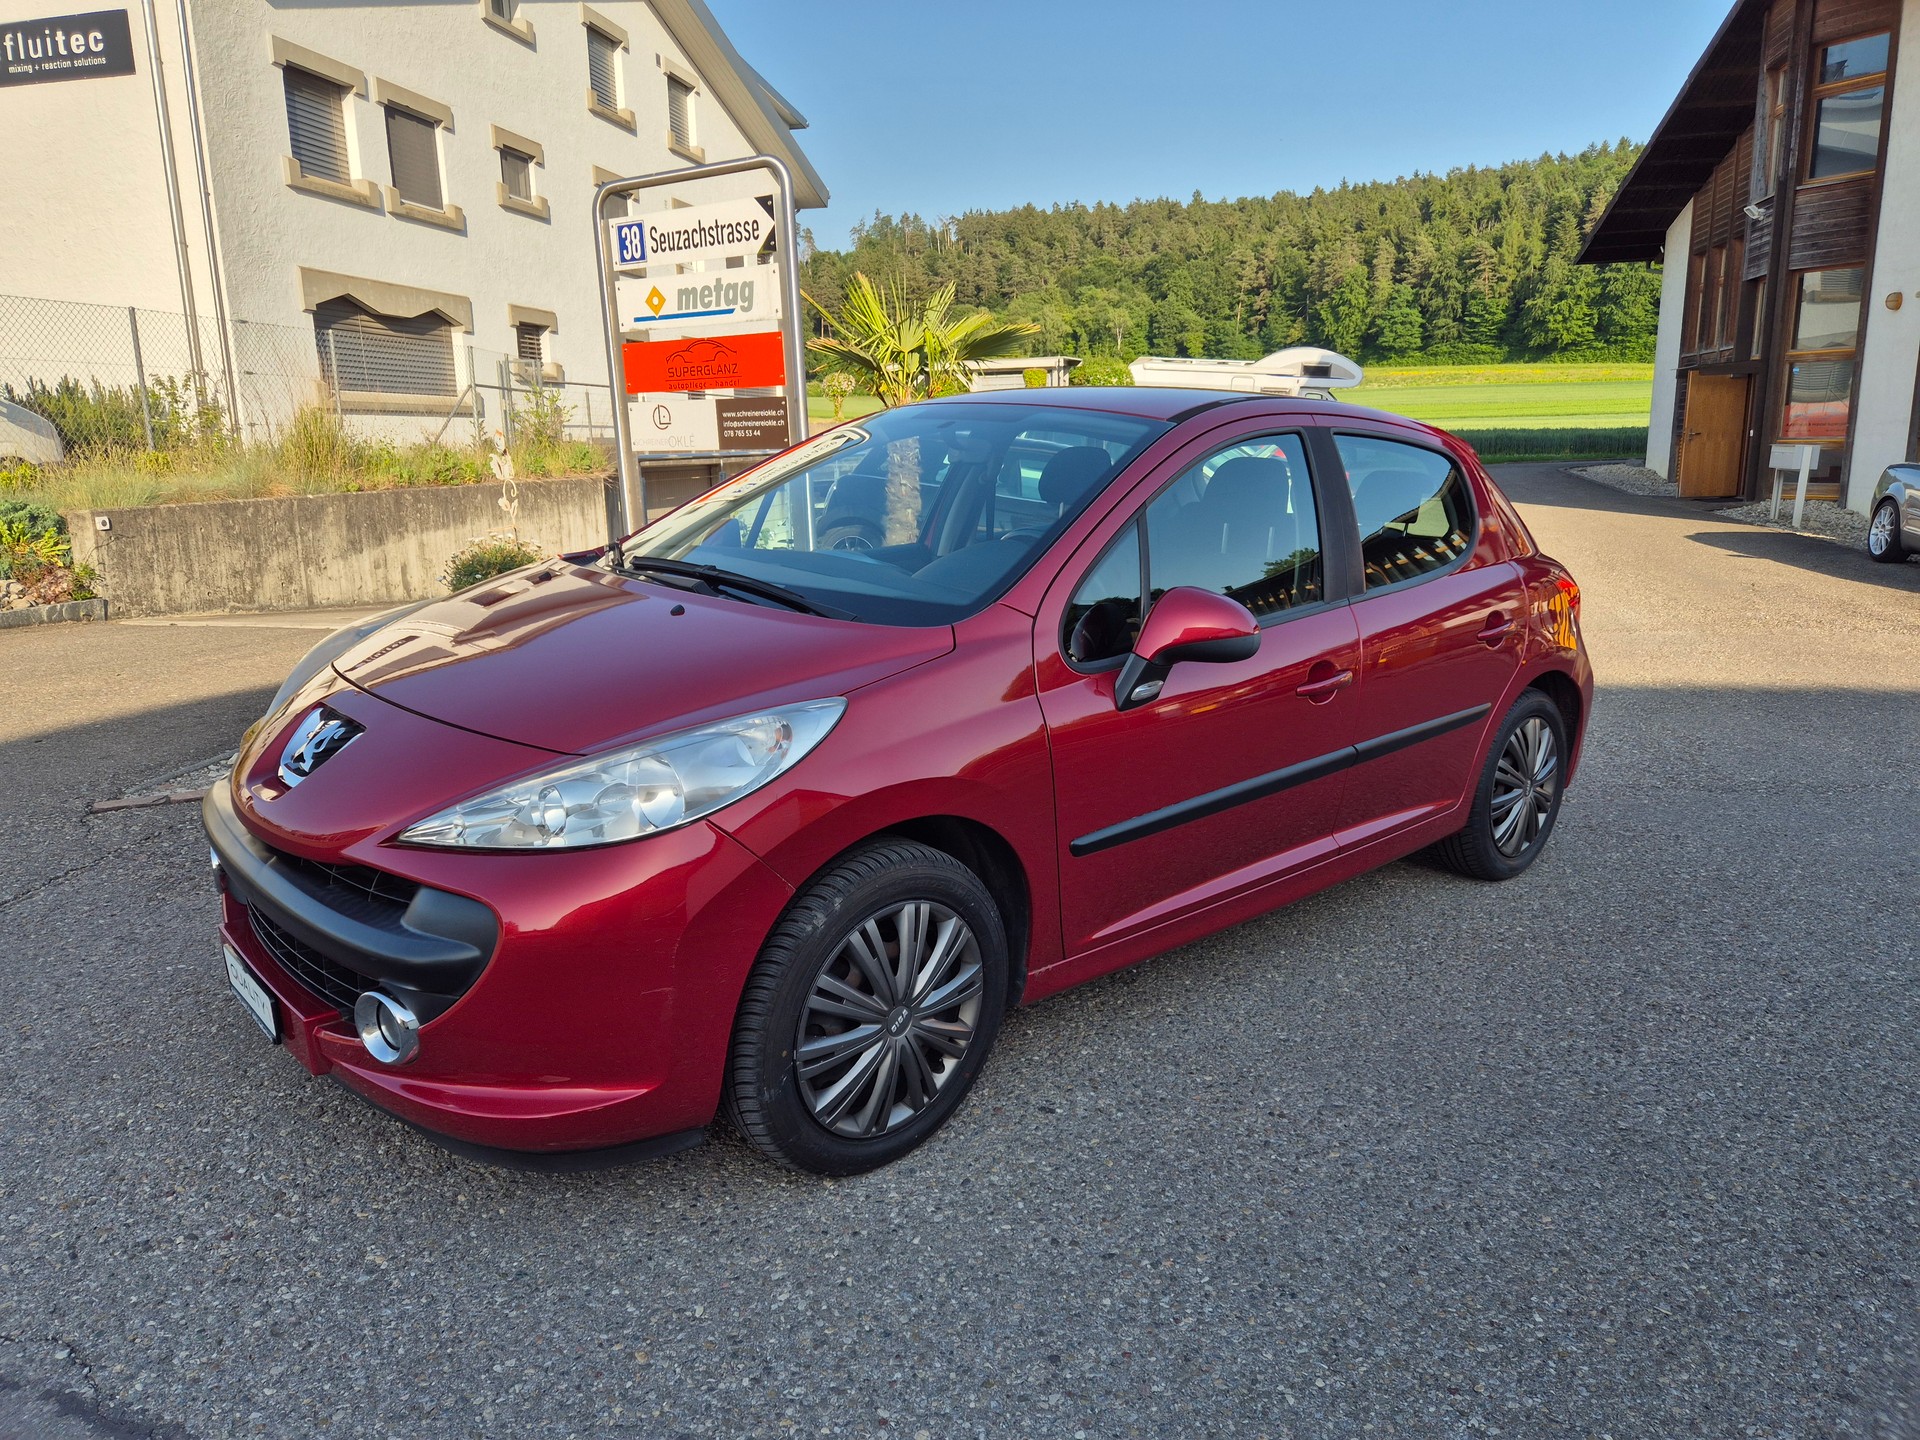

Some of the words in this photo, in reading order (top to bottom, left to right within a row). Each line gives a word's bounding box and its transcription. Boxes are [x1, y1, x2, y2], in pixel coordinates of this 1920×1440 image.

[3, 29, 104, 61] fluitec
[8, 64, 32, 73] mixing
[42, 60, 71, 70] reaction
[74, 56, 106, 66] solutions
[621, 225, 642, 260] 38
[650, 219, 760, 253] Seuzachstrasse
[677, 278, 754, 313] metag
[668, 363, 738, 378] SUPERGLANZ
[716, 379, 740, 387] handel
